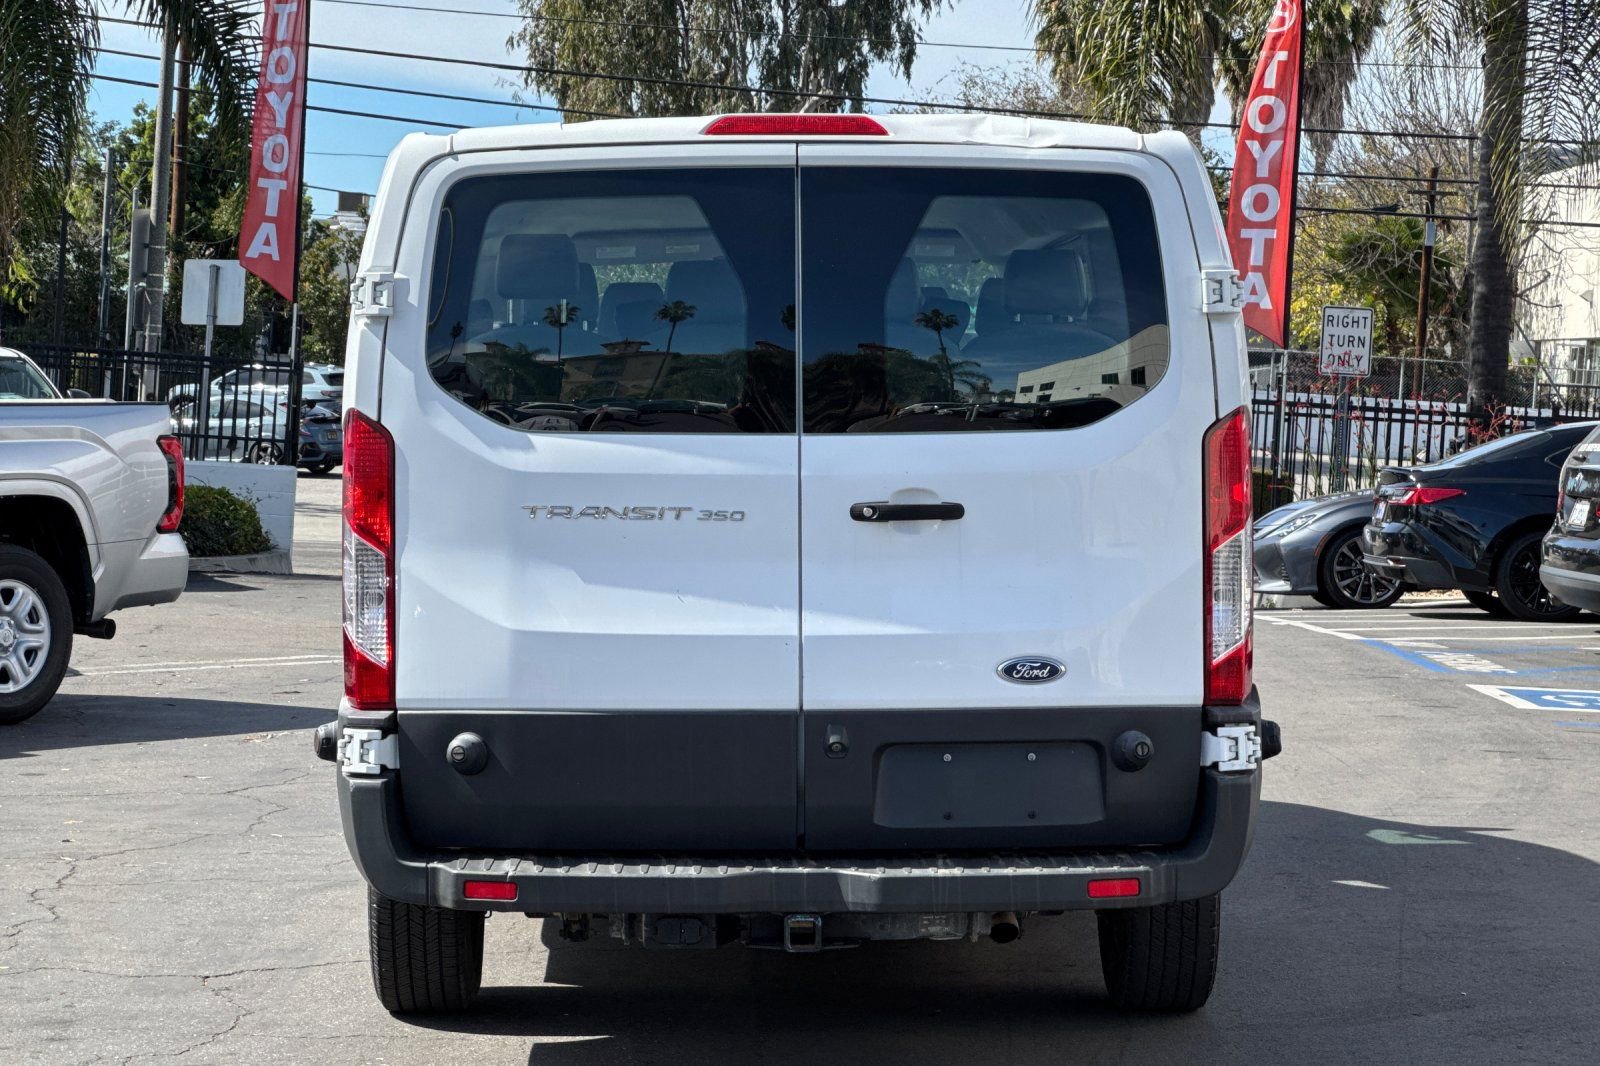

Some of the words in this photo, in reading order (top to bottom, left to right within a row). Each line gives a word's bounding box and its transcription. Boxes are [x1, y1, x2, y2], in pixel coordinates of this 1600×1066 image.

[245, 3, 297, 261] TOYOTA
[1240, 51, 1289, 310] TOYOTA
[1326, 314, 1369, 329] RIGHT
[1328, 334, 1366, 349] TURN
[1327, 353, 1363, 368] ONLY
[521, 505, 693, 521] TRANSIT
[697, 509, 745, 522] 350
[1012, 662, 1051, 678] Ford
